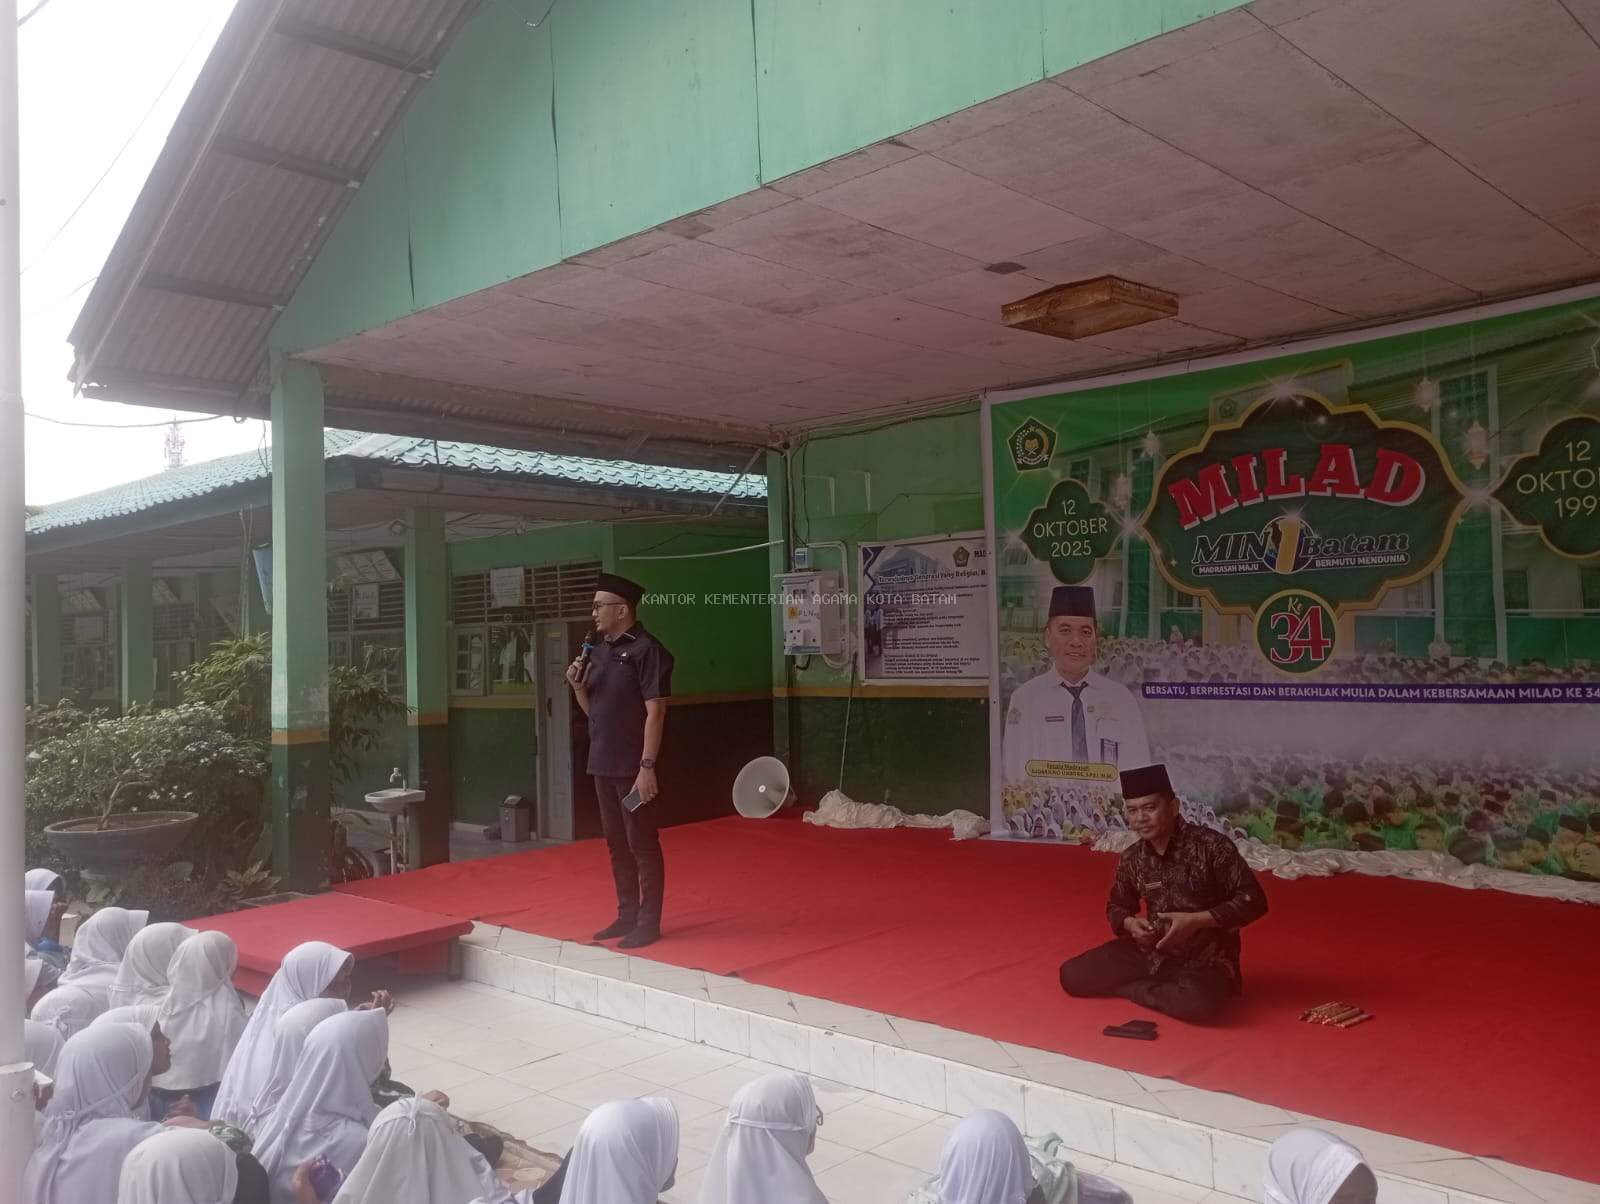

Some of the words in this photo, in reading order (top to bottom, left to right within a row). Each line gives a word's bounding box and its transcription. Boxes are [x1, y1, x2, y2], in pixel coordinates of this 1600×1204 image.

[1565, 441, 1591, 462] 12
[1168, 444, 1426, 530] MILAD
[1516, 468, 1600, 494] OKTO
[1062, 499, 1077, 515] 12
[1554, 495, 1600, 518] 199
[1033, 517, 1108, 538] OKTOBER
[1050, 540, 1092, 557] 2025
[1192, 531, 1273, 564] MIN
[1276, 519, 1302, 573] 1
[1299, 533, 1410, 557] Batam
[1199, 566, 1237, 574] MADRASAH
[1240, 563, 1259, 573] MAJU
[1315, 557, 1355, 568] BERMUTU
[1357, 553, 1405, 566] MENDUNIA
[1271, 606, 1331, 664] 34
[1145, 686, 1188, 696] BERSATU,
[1190, 686, 1250, 696] BERPRESTASI
[1253, 687, 1275, 696] DAN
[1278, 687, 1338, 697] BERAKHLAK
[1341, 687, 1375, 698] MULIA
[1378, 688, 1420, 699] DALAM
[1423, 688, 1515, 699] KEBERSAMAAN
[1519, 688, 1562, 698] MILAD
[1566, 688, 1583, 698] KE
[1585, 688, 1600, 699] 34
